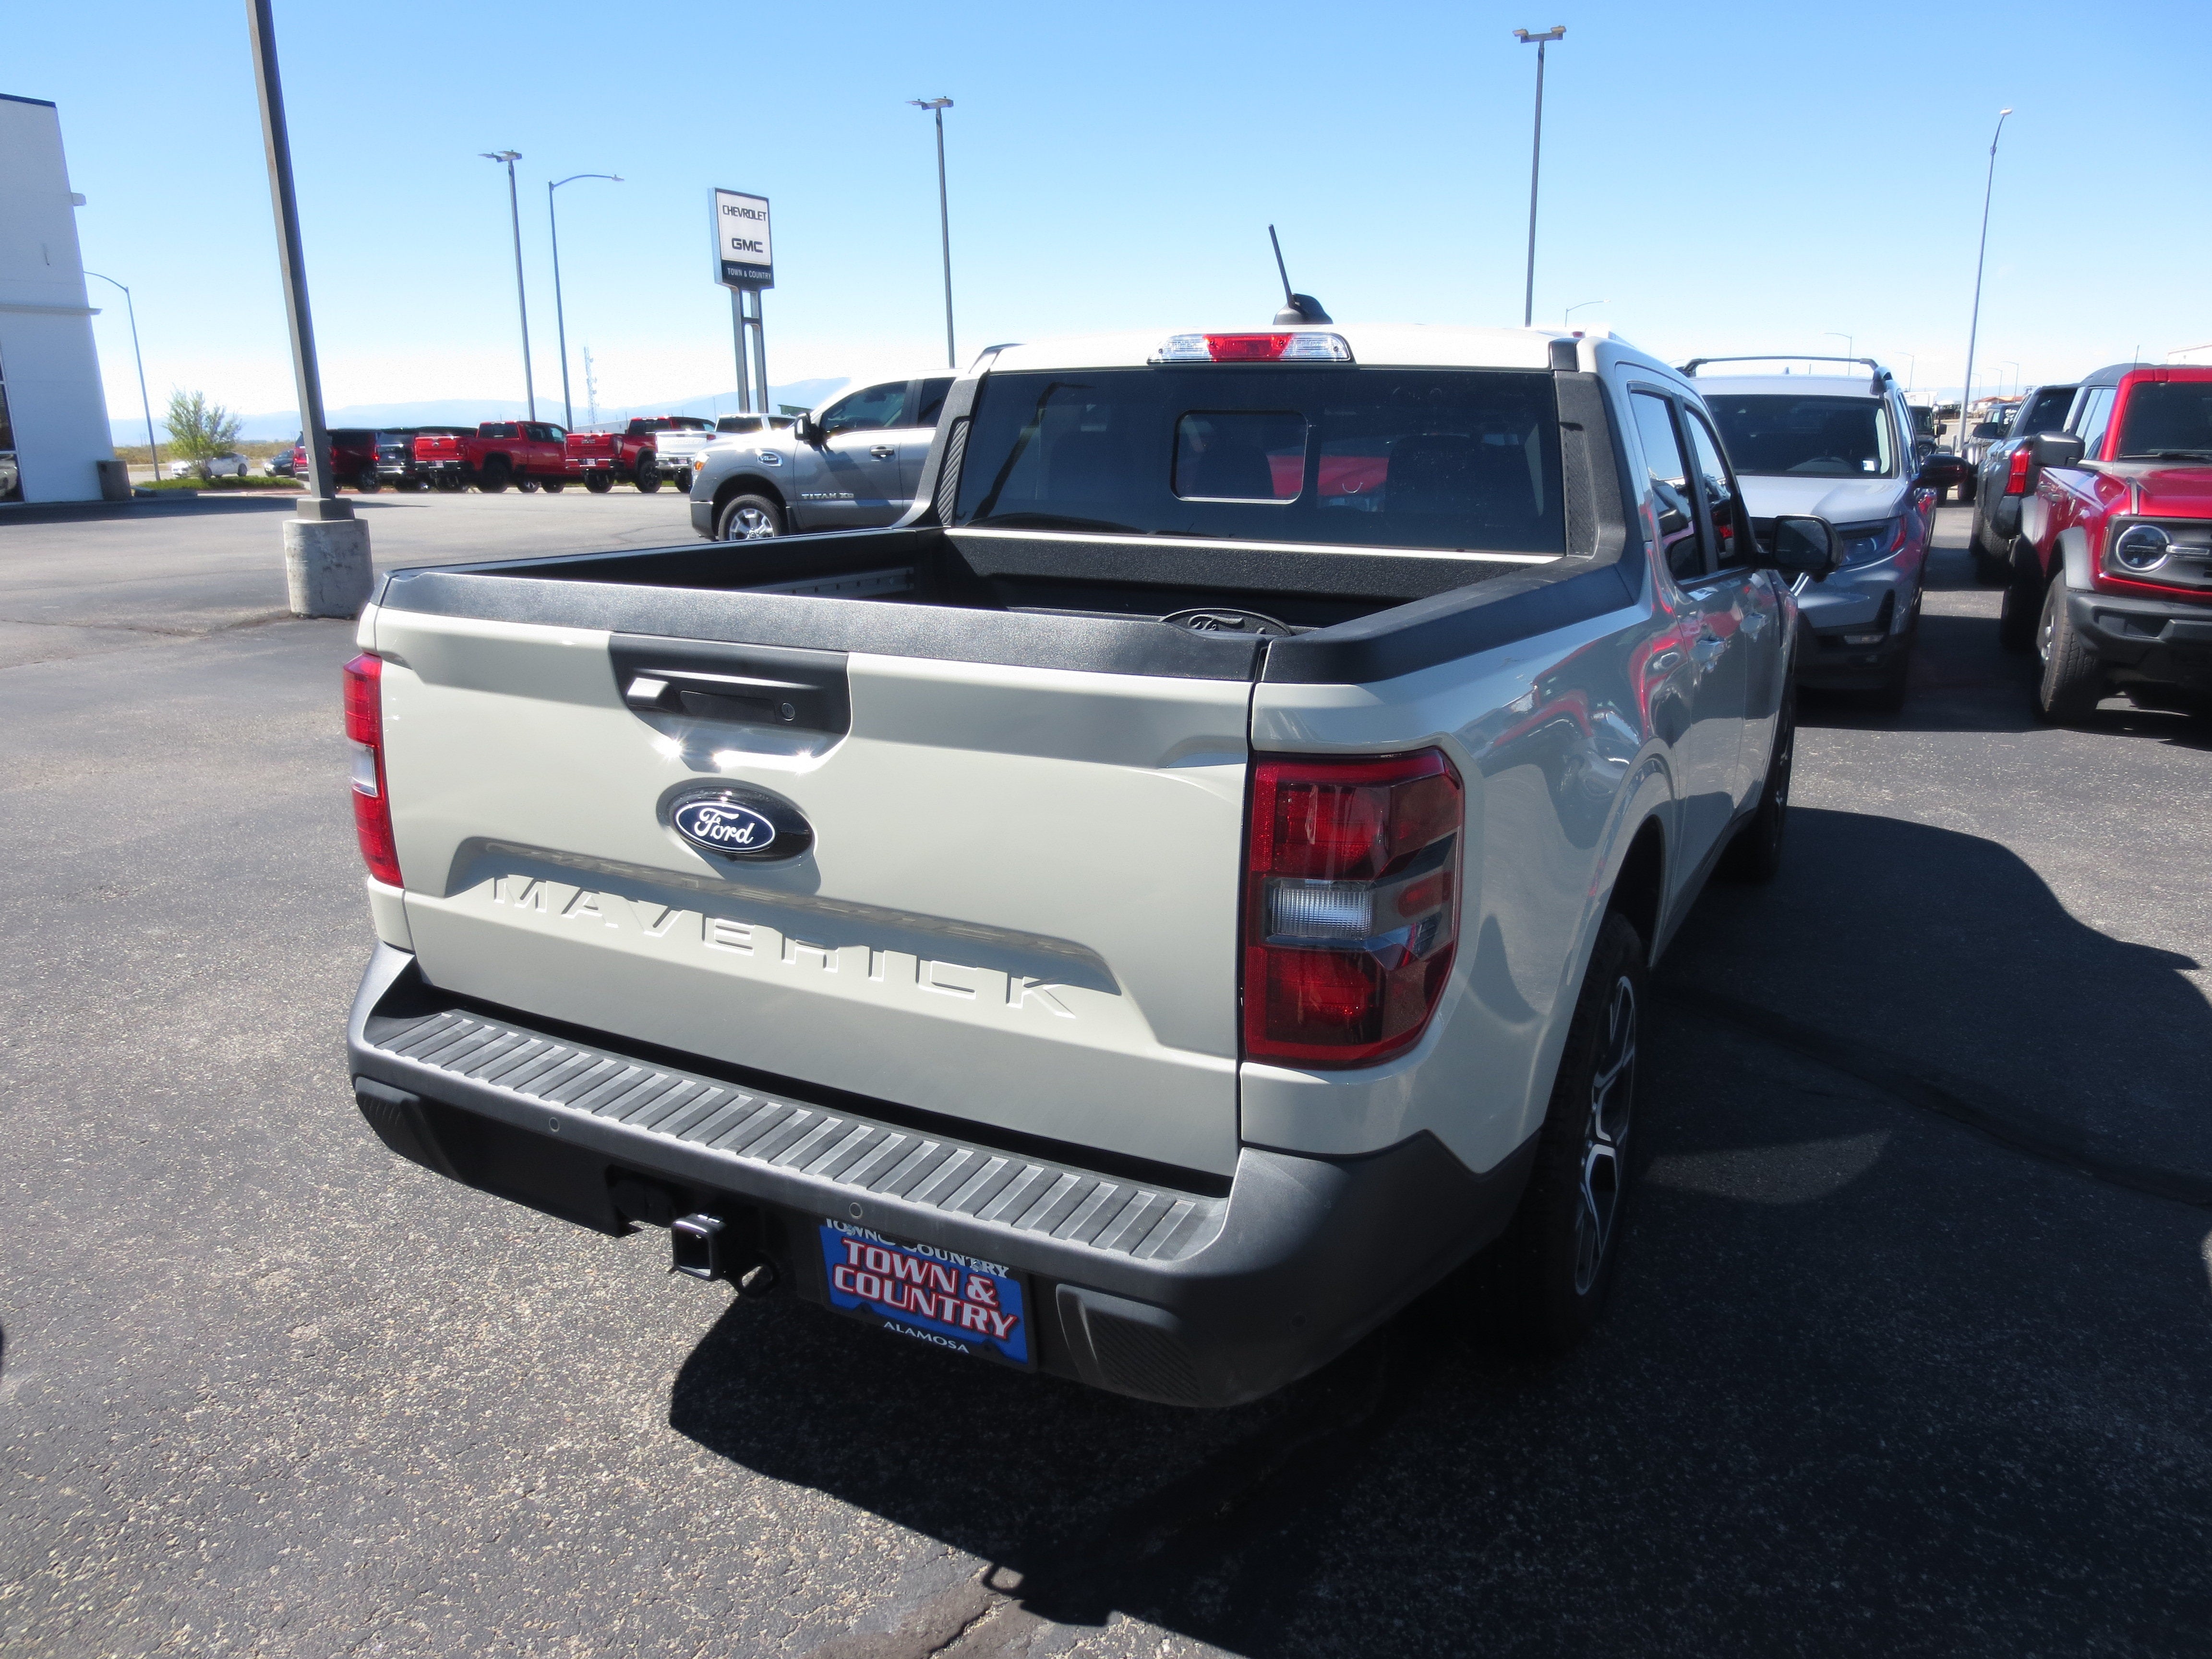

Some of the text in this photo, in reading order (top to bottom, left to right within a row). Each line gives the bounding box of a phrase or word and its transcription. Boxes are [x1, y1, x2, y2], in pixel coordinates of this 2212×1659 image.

[722, 204, 767, 221] CHEVROLET
[732, 238, 763, 253] GMC
[727, 267, 743, 276] TOWN
[748, 270, 771, 279] COUNTRY
[694, 807, 756, 844] Ford
[493, 877, 1077, 1019] MAVERICK
[842, 1237, 999, 1308] TOWN &
[833, 1263, 1017, 1340] COUNTRY
[883, 1321, 970, 1354] ALAMOSA
